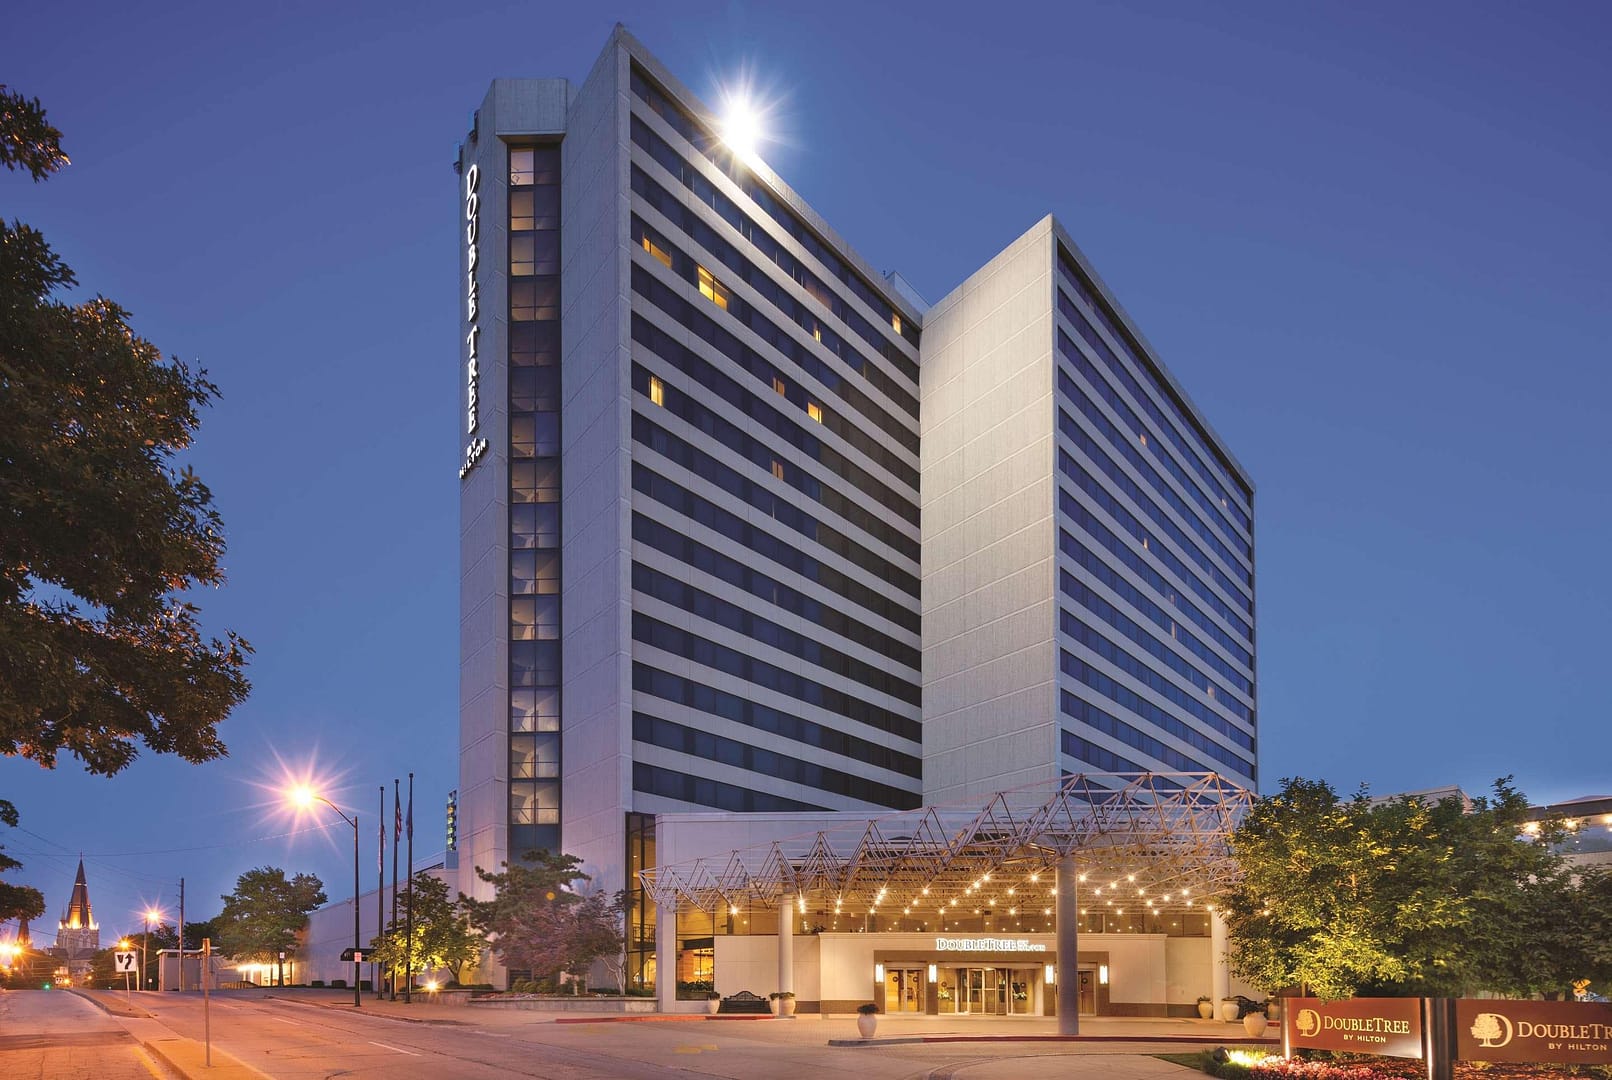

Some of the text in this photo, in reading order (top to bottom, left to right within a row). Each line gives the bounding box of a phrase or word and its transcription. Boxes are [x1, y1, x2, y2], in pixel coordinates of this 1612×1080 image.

[466, 438, 477, 457] BY
[459, 437, 486, 479] HILTON
[936, 938, 1017, 952] DOUBLETREE
[1324, 1015, 1411, 1034] DOUBLETREE
[1357, 1034, 1387, 1043] HILTON
[1548, 1042, 1562, 1050] BY
[1568, 1043, 1607, 1051] HILTON
